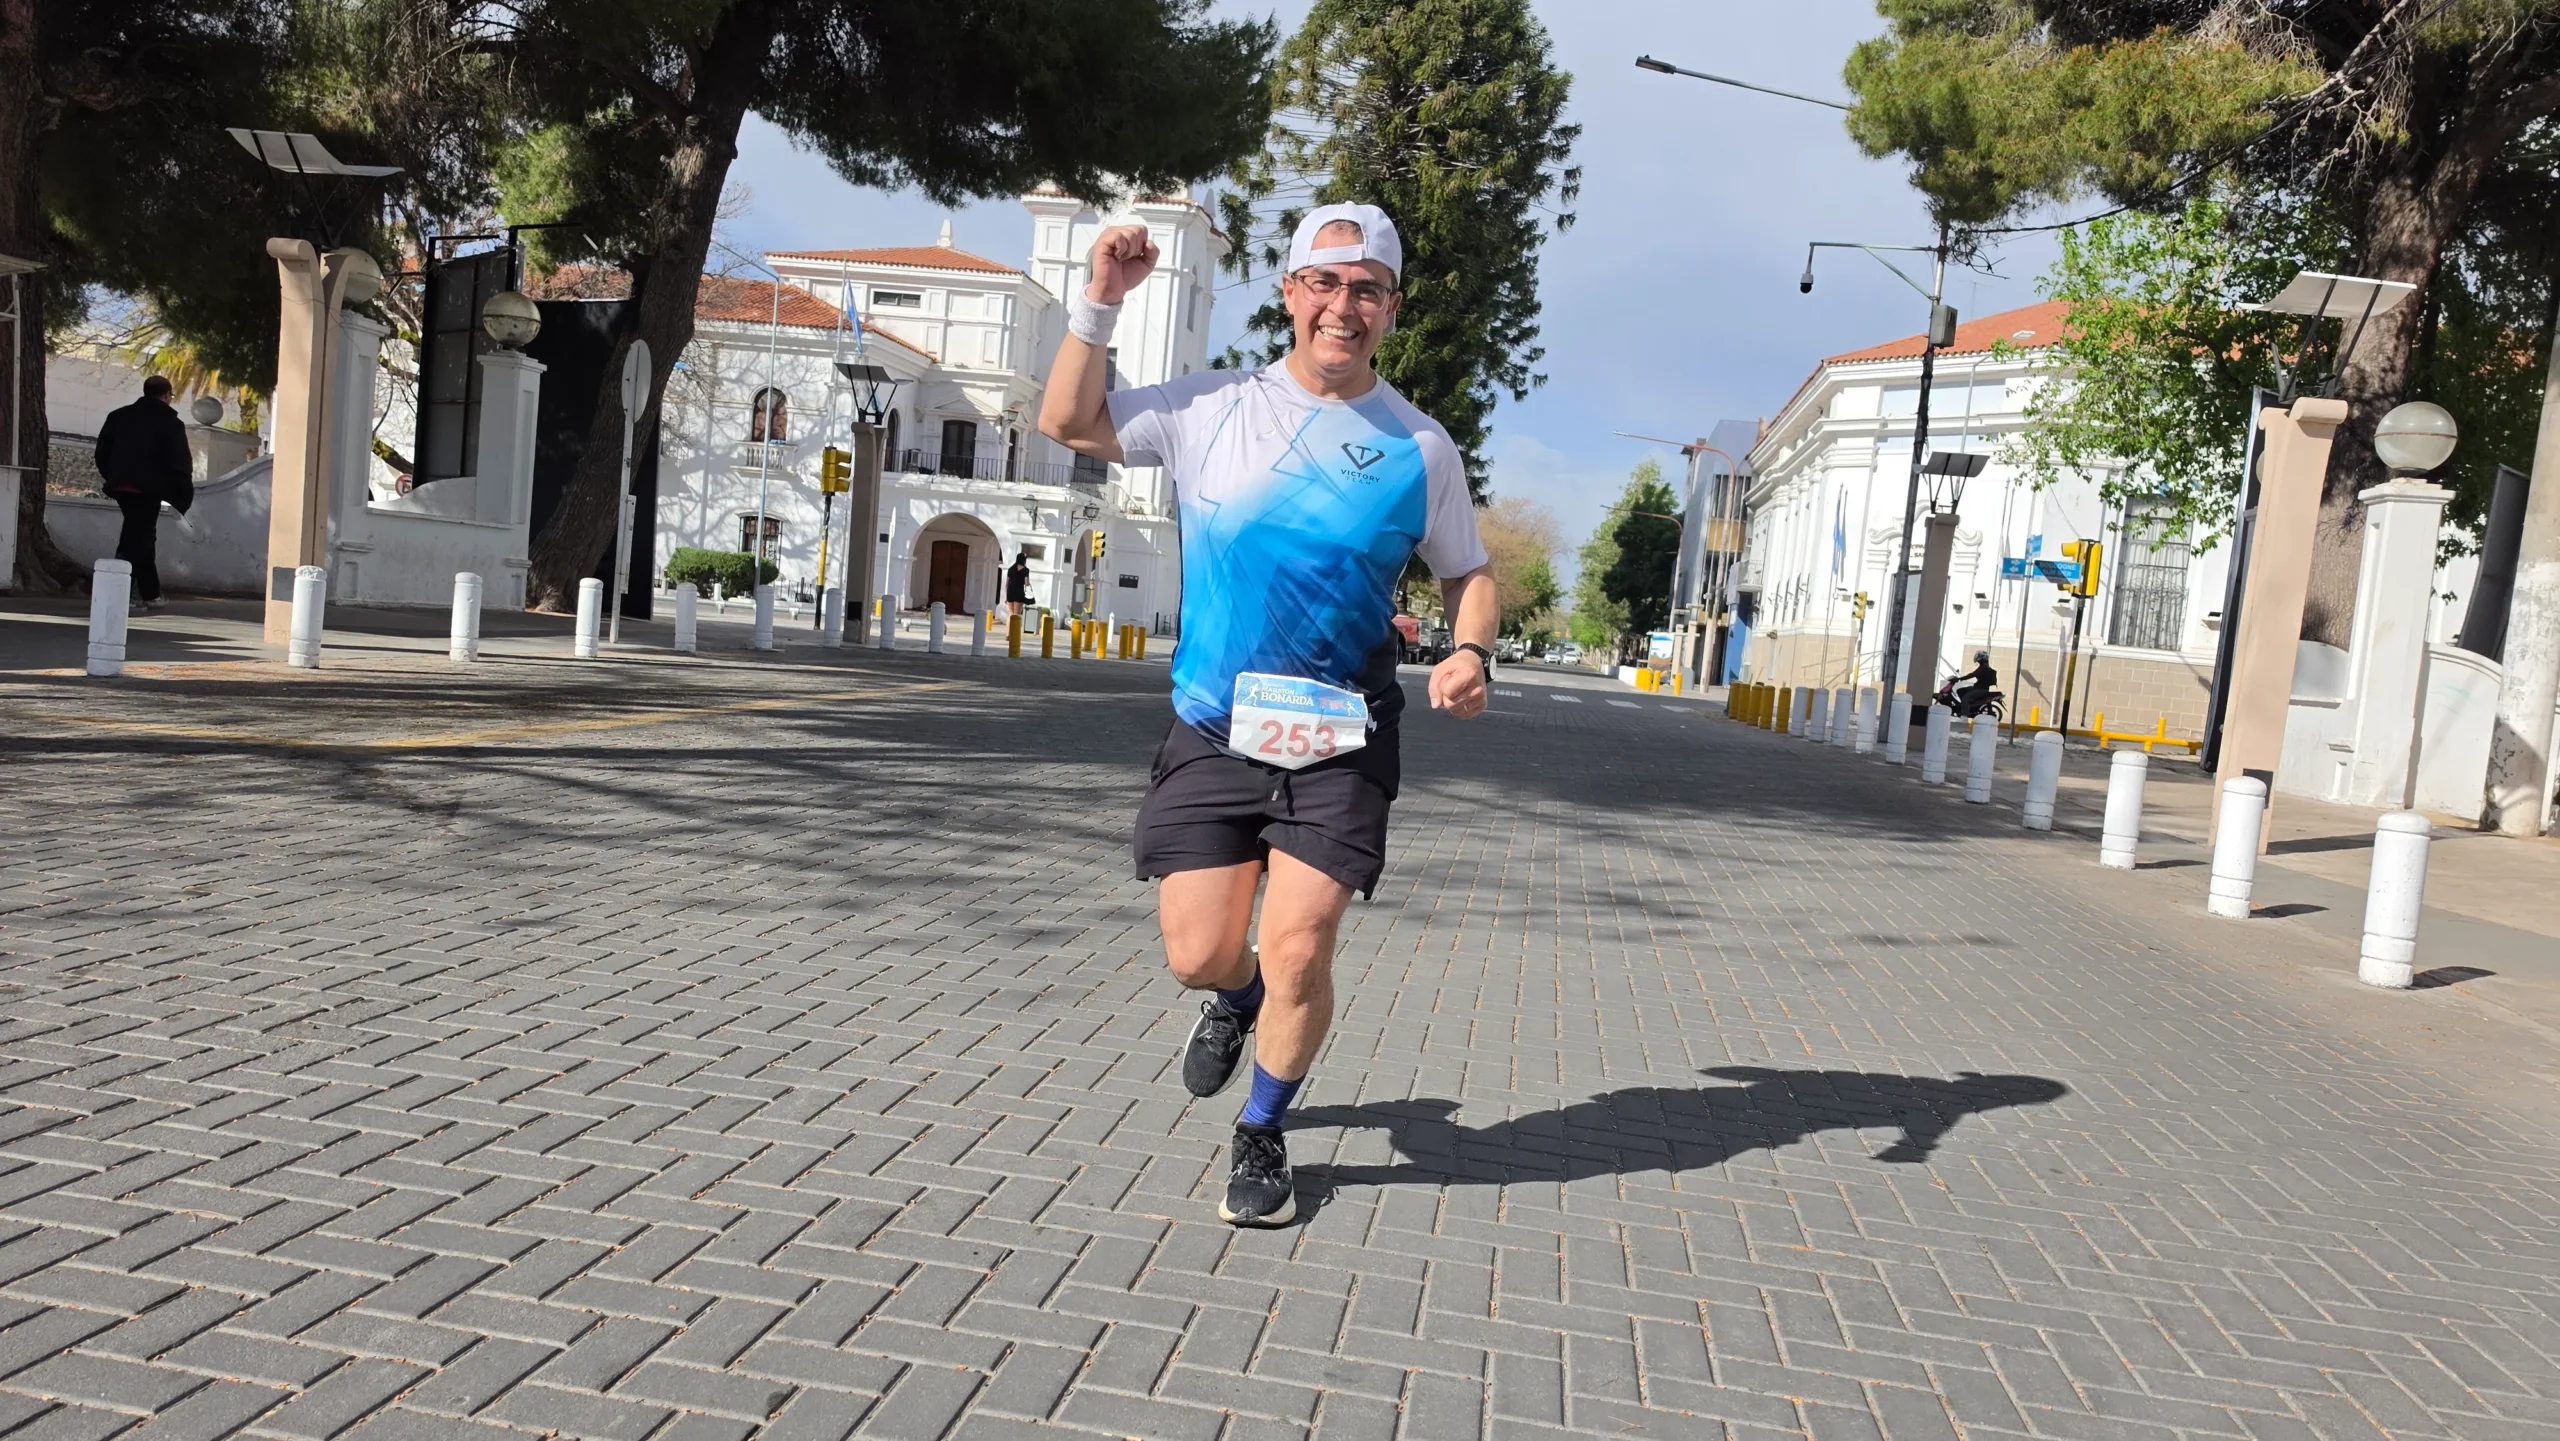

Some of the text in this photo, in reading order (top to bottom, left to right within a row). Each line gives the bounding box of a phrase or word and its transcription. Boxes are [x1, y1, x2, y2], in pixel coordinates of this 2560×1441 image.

[1340, 469, 1380, 483] VICTORY
[1261, 692, 1314, 707] BONARDA
[1258, 720, 1337, 758] 253
